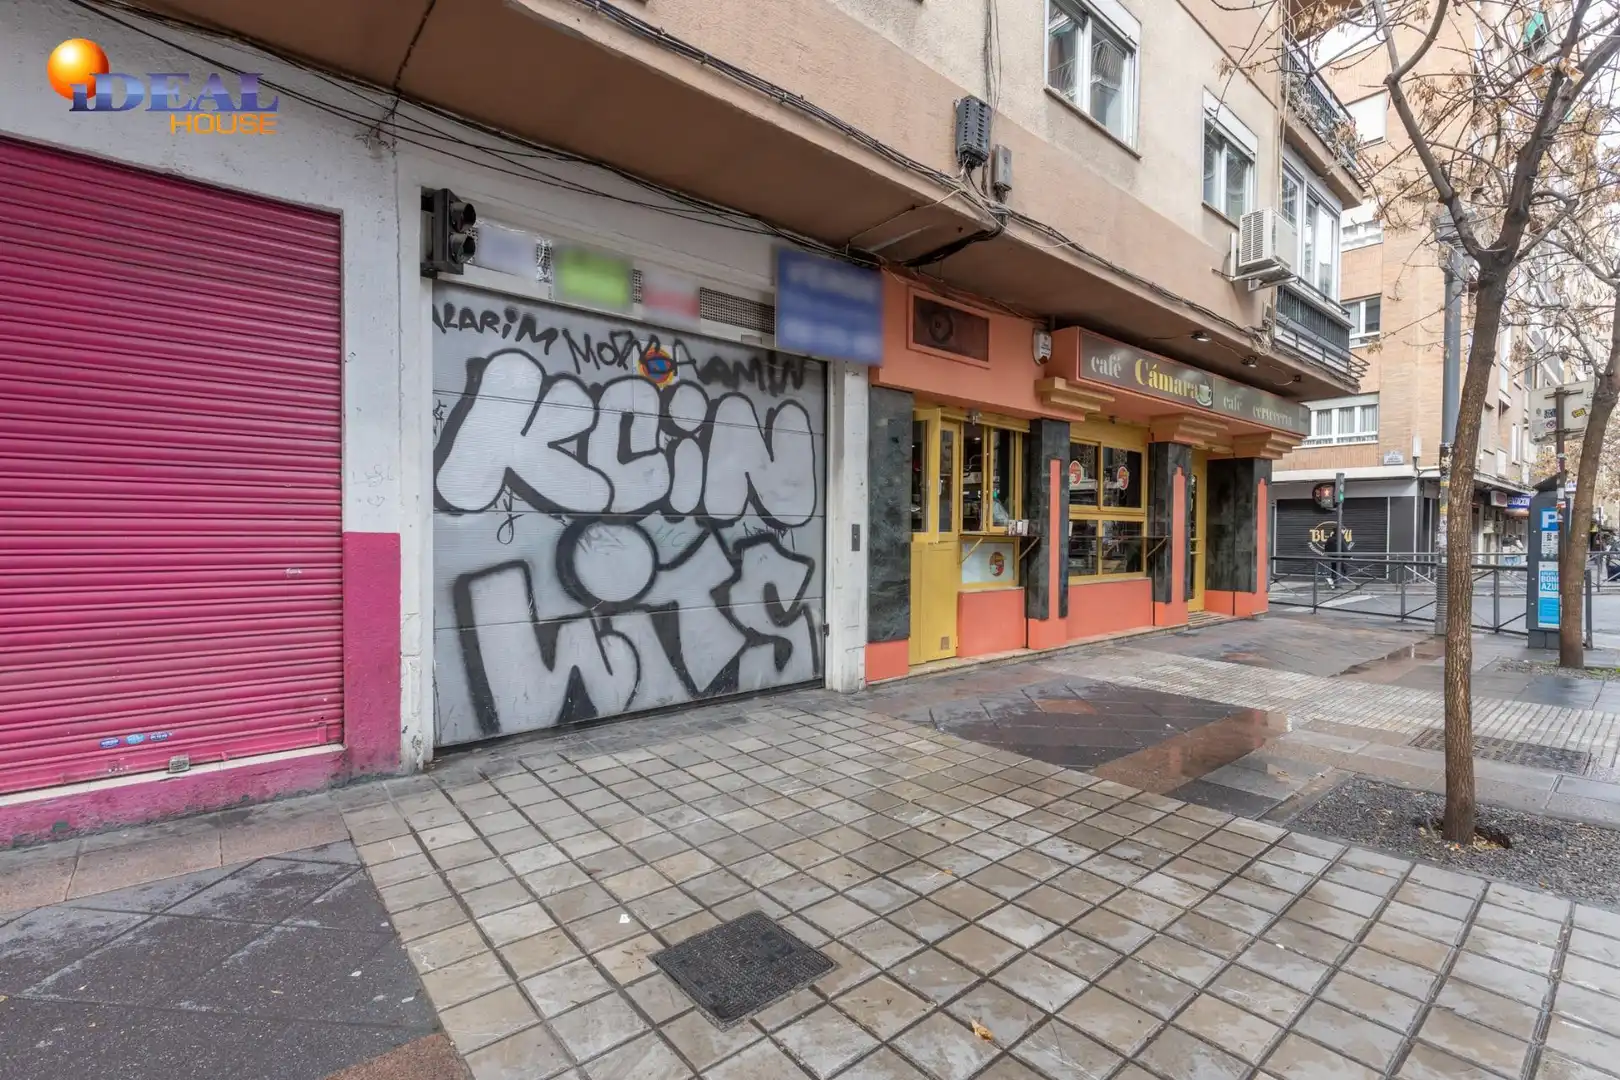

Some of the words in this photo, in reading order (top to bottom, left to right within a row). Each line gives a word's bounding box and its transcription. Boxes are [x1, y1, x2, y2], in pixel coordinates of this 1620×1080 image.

[1090, 353, 1122, 379] café
[1134, 358, 1199, 399] Cámara
[1541, 511, 1557, 529] P
